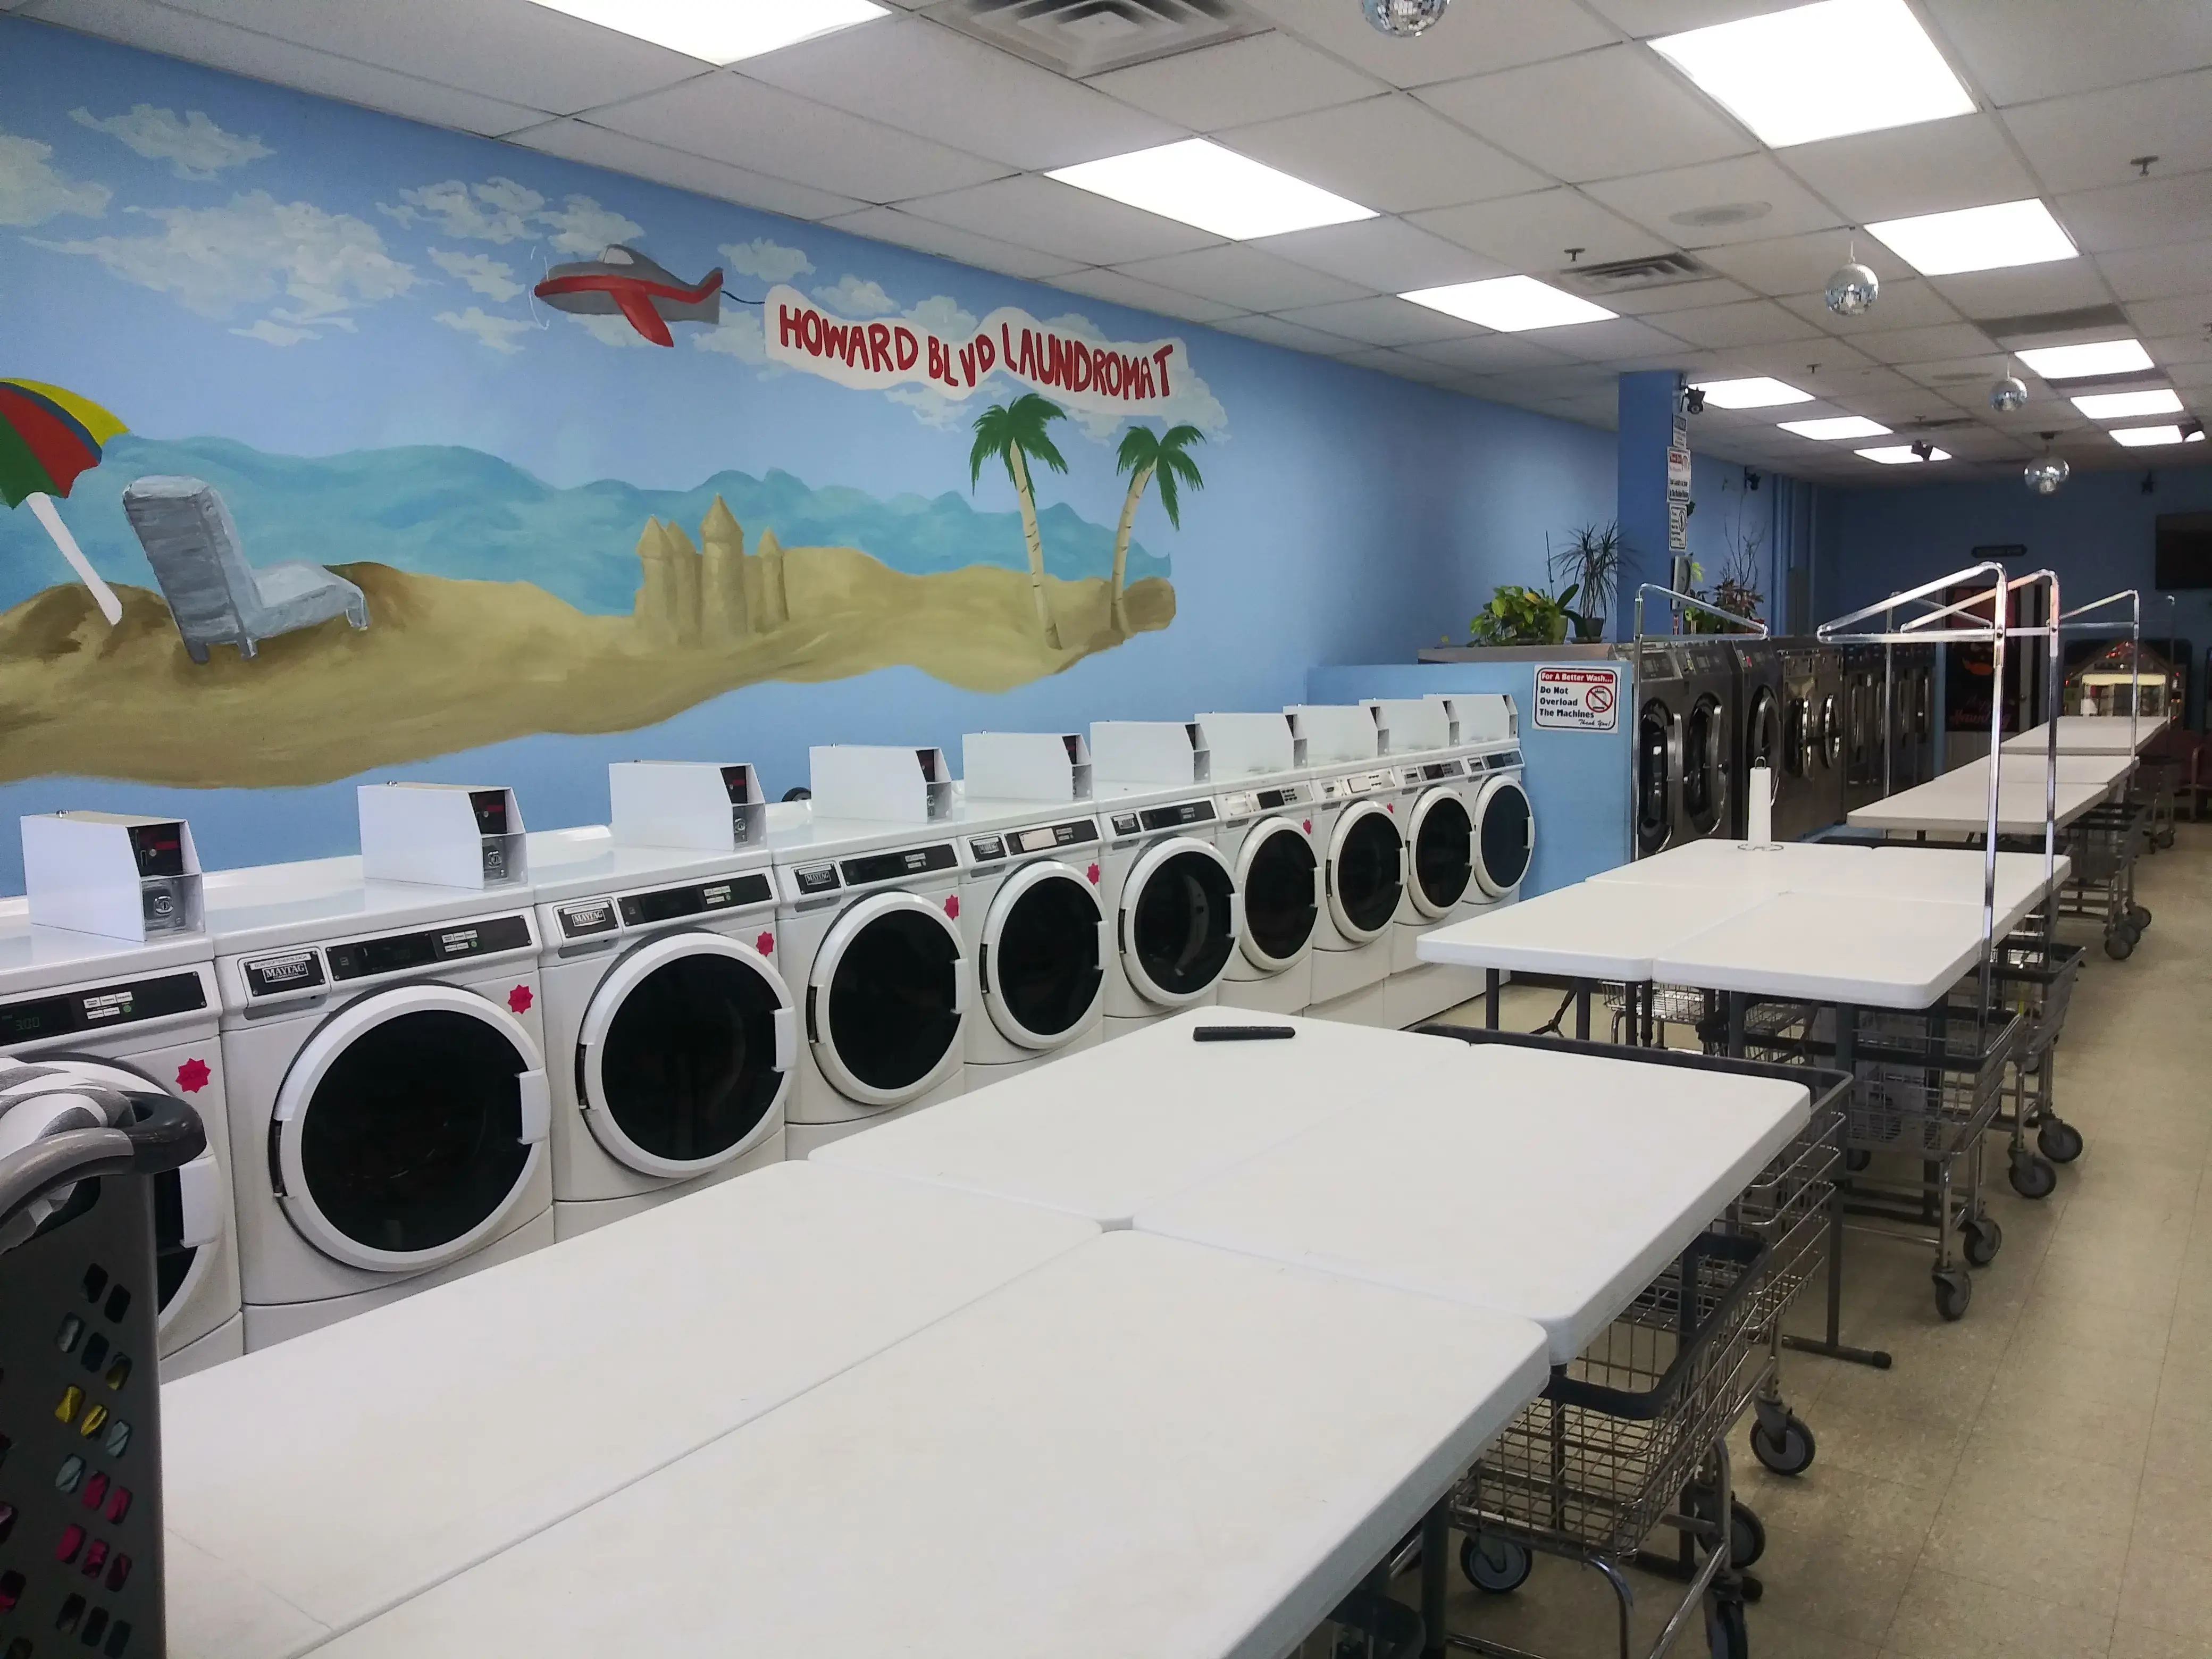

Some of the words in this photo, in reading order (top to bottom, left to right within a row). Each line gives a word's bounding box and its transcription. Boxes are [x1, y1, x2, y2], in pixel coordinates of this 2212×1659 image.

[780, 304, 918, 372] HOWARD
[928, 329, 995, 387] BLVD
[1001, 322, 1174, 400] LAUNDROMAT
[1586, 674, 1613, 683] Wash...
[1540, 685, 1551, 694] Do
[1554, 686, 1569, 695] Not
[1540, 697, 1578, 706] Overload
[1539, 708, 1554, 717] The
[1556, 709, 1595, 718] Machines
[574, 911, 603, 923] MAYTAG
[266, 963, 305, 978] MAYTAG
